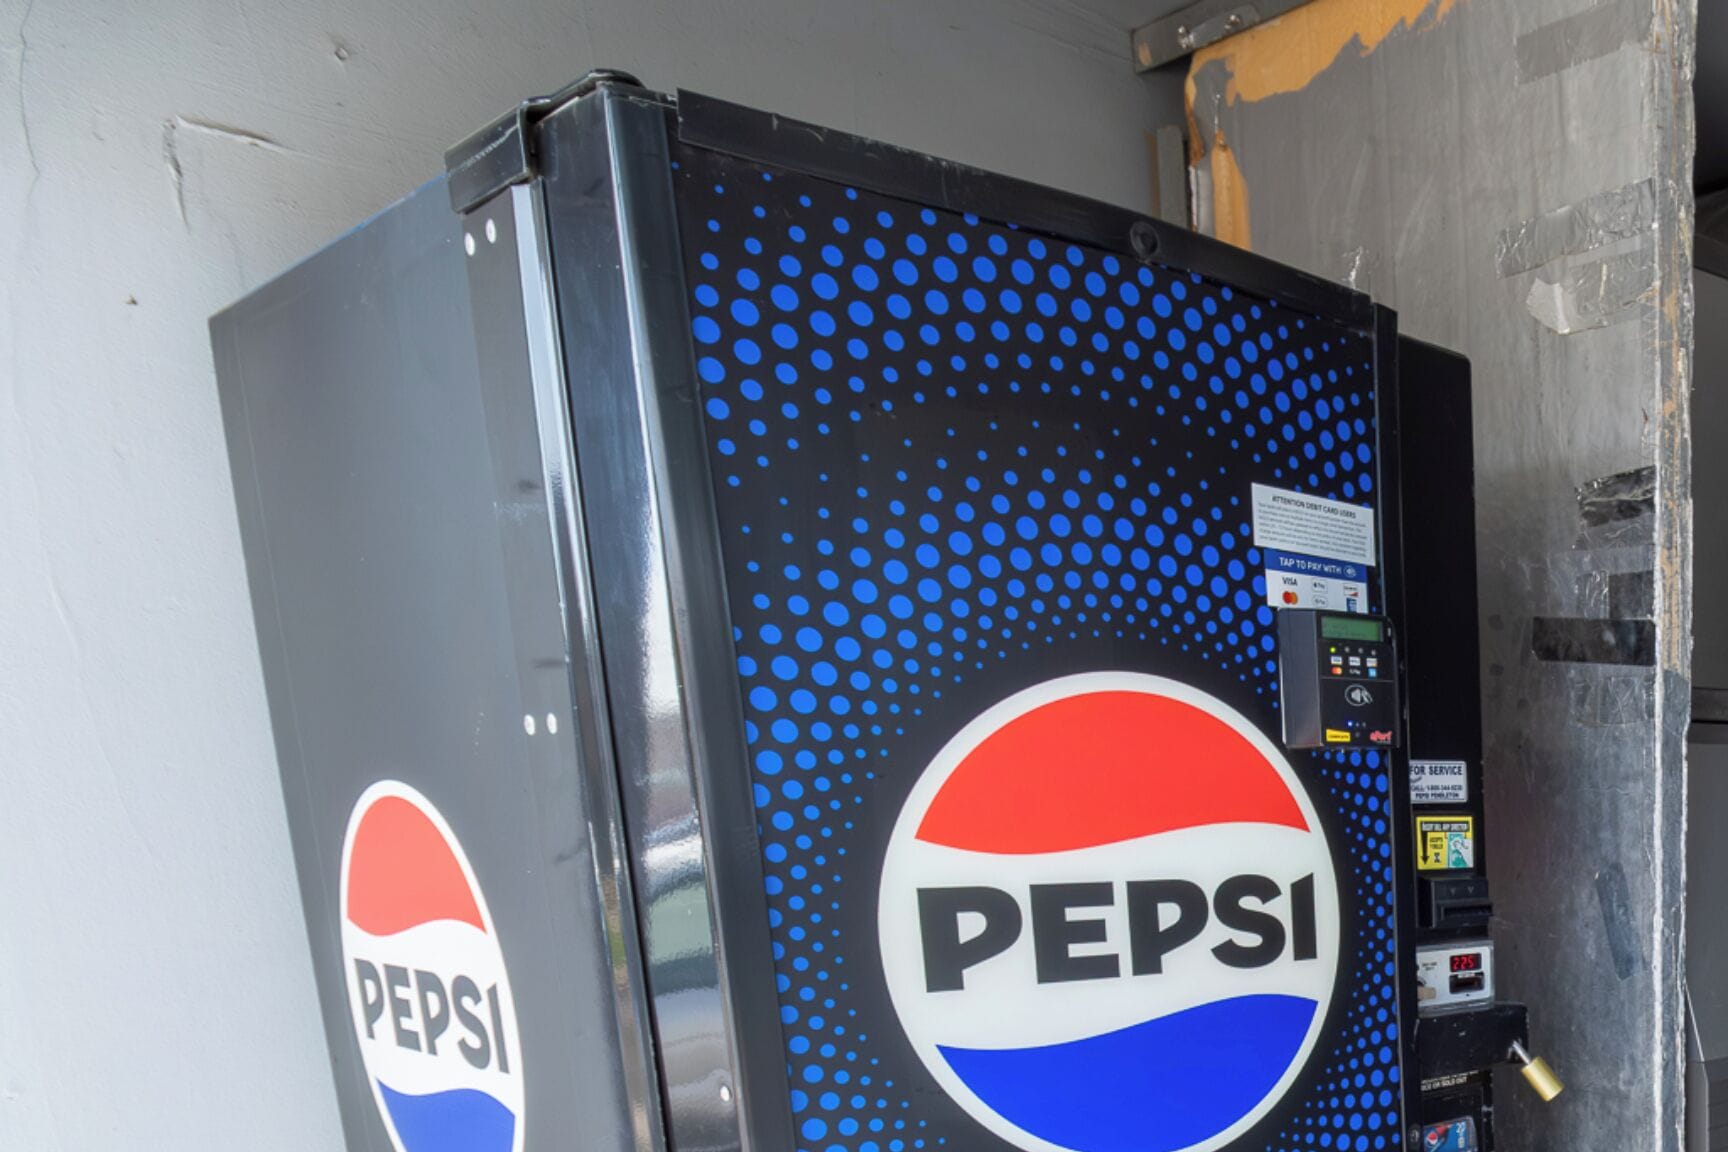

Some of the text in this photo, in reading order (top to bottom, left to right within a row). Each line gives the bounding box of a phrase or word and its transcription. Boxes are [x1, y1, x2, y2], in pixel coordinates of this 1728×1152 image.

[1272, 495, 1356, 519] ATTENTION DEBIT CARD USERS
[1279, 557, 1342, 575] TAP TO PAY WITH
[1282, 576, 1298, 587] VISA
[1409, 766, 1463, 776] FOR SERVICE
[916, 871, 1318, 993] PEPSI
[354, 957, 510, 1075] PEPSI
